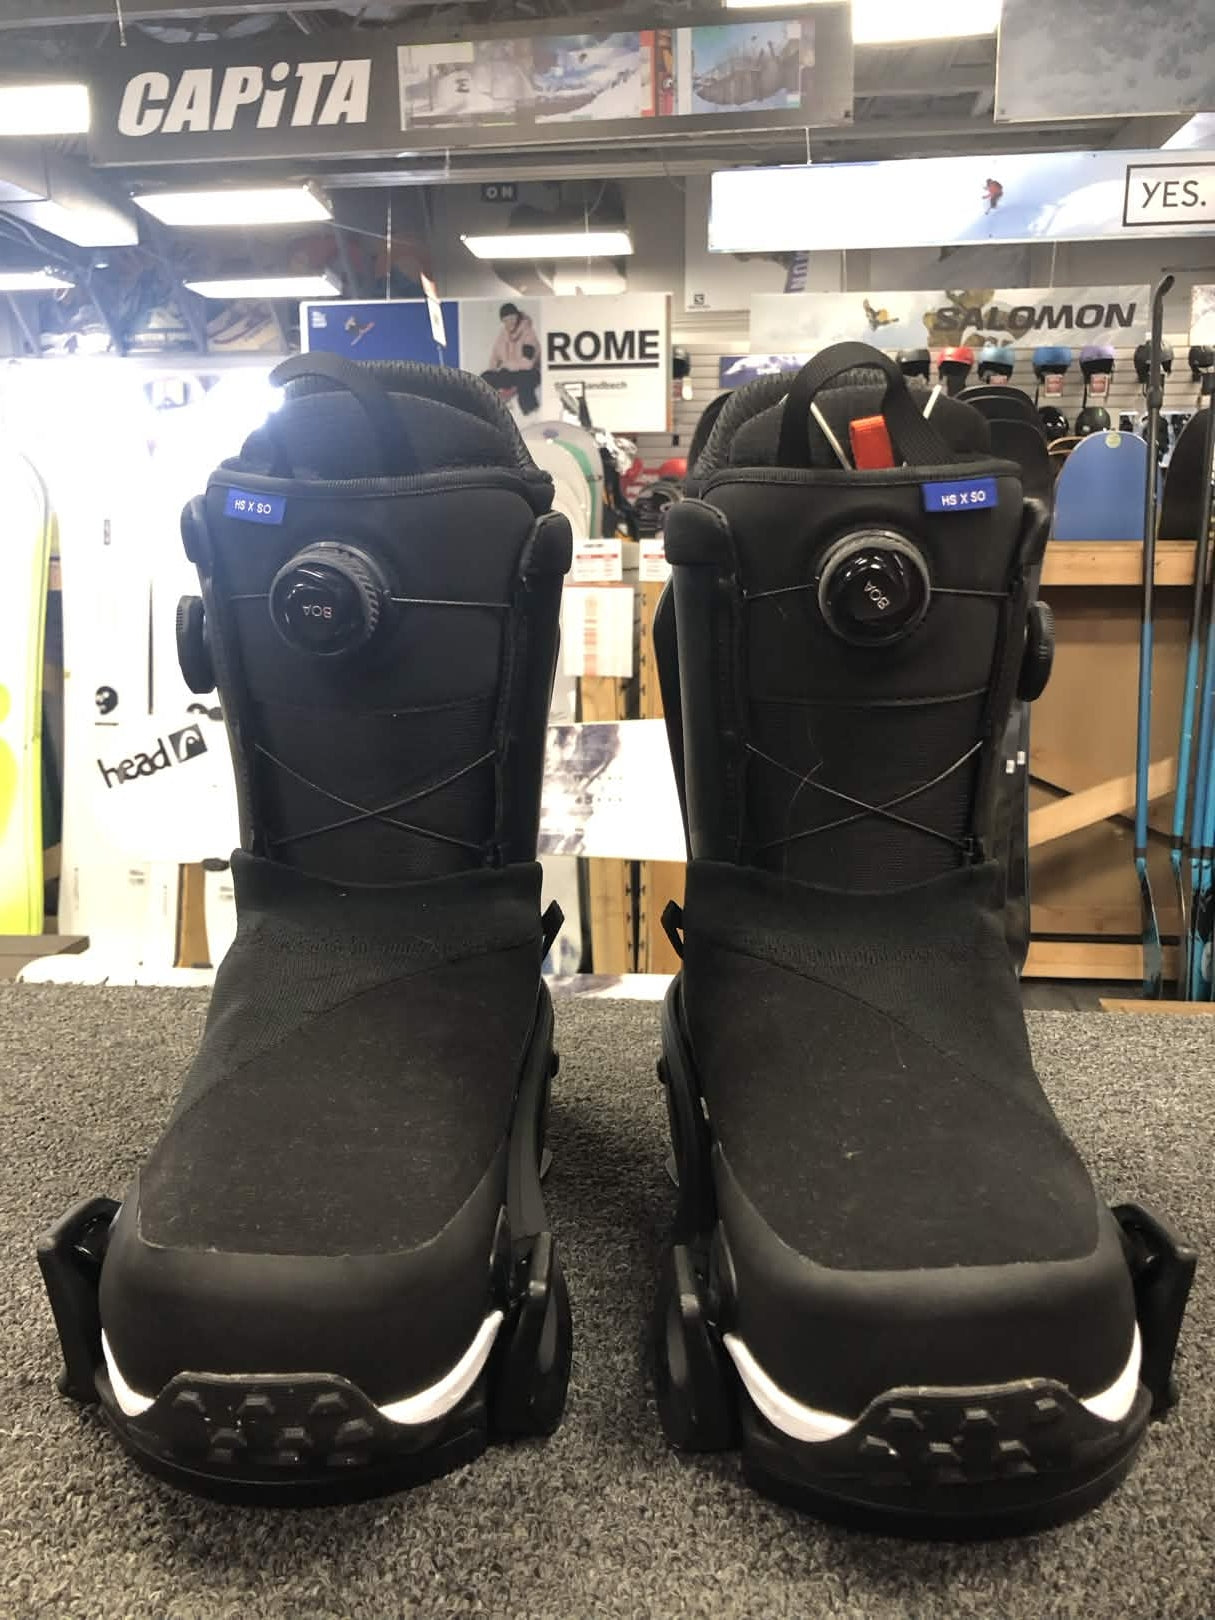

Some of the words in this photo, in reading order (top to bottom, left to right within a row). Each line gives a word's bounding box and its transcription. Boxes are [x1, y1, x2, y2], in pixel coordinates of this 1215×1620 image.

[1141, 180, 1206, 208] YES.
[935, 303, 1136, 331] SALOMON
[547, 330, 659, 361] ROME
[234, 499, 246, 511] HS
[247, 501, 255, 512] X
[941, 494, 957, 506] HS
[960, 493, 969, 504] X
[864, 580, 890, 610] BOA
[302, 604, 333, 618] BOA
[97, 738, 171, 788] head
